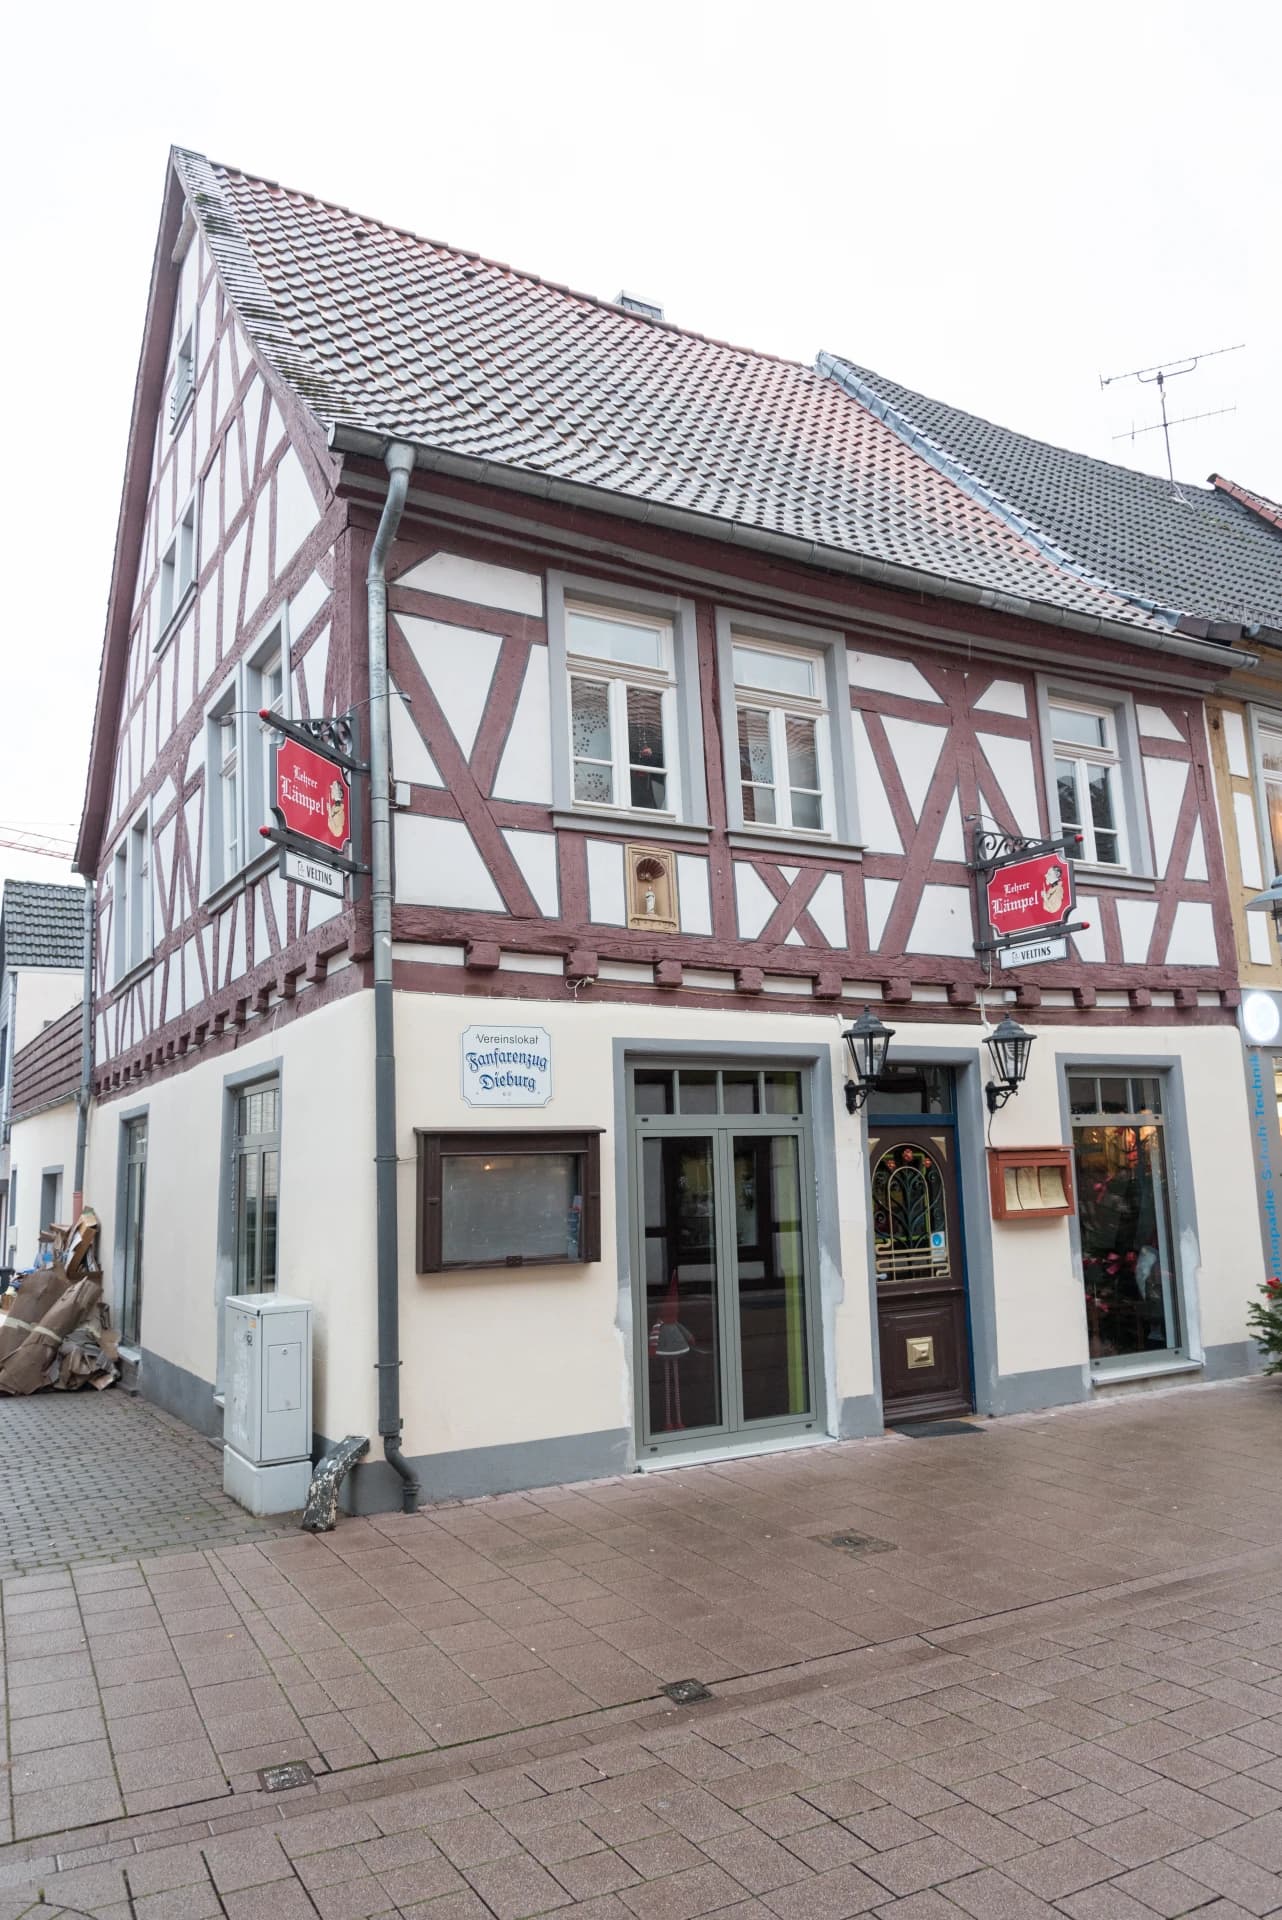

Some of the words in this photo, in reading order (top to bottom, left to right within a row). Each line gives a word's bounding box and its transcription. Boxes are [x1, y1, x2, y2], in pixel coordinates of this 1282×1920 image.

[292, 764, 318, 789] Lehrer
[280, 775, 325, 816] Lämpel
[306, 865, 333, 886] VELTINS
[1003, 882, 1031, 897] Lehrer
[991, 889, 1039, 920] Lämpel
[1020, 945, 1052, 961] VELTINS
[476, 1033, 538, 1045] Vereinslokal
[465, 1048, 548, 1074] Fanfarenzug
[479, 1070, 537, 1093] Dieburg
[1248, 1053, 1265, 1116] Technik
